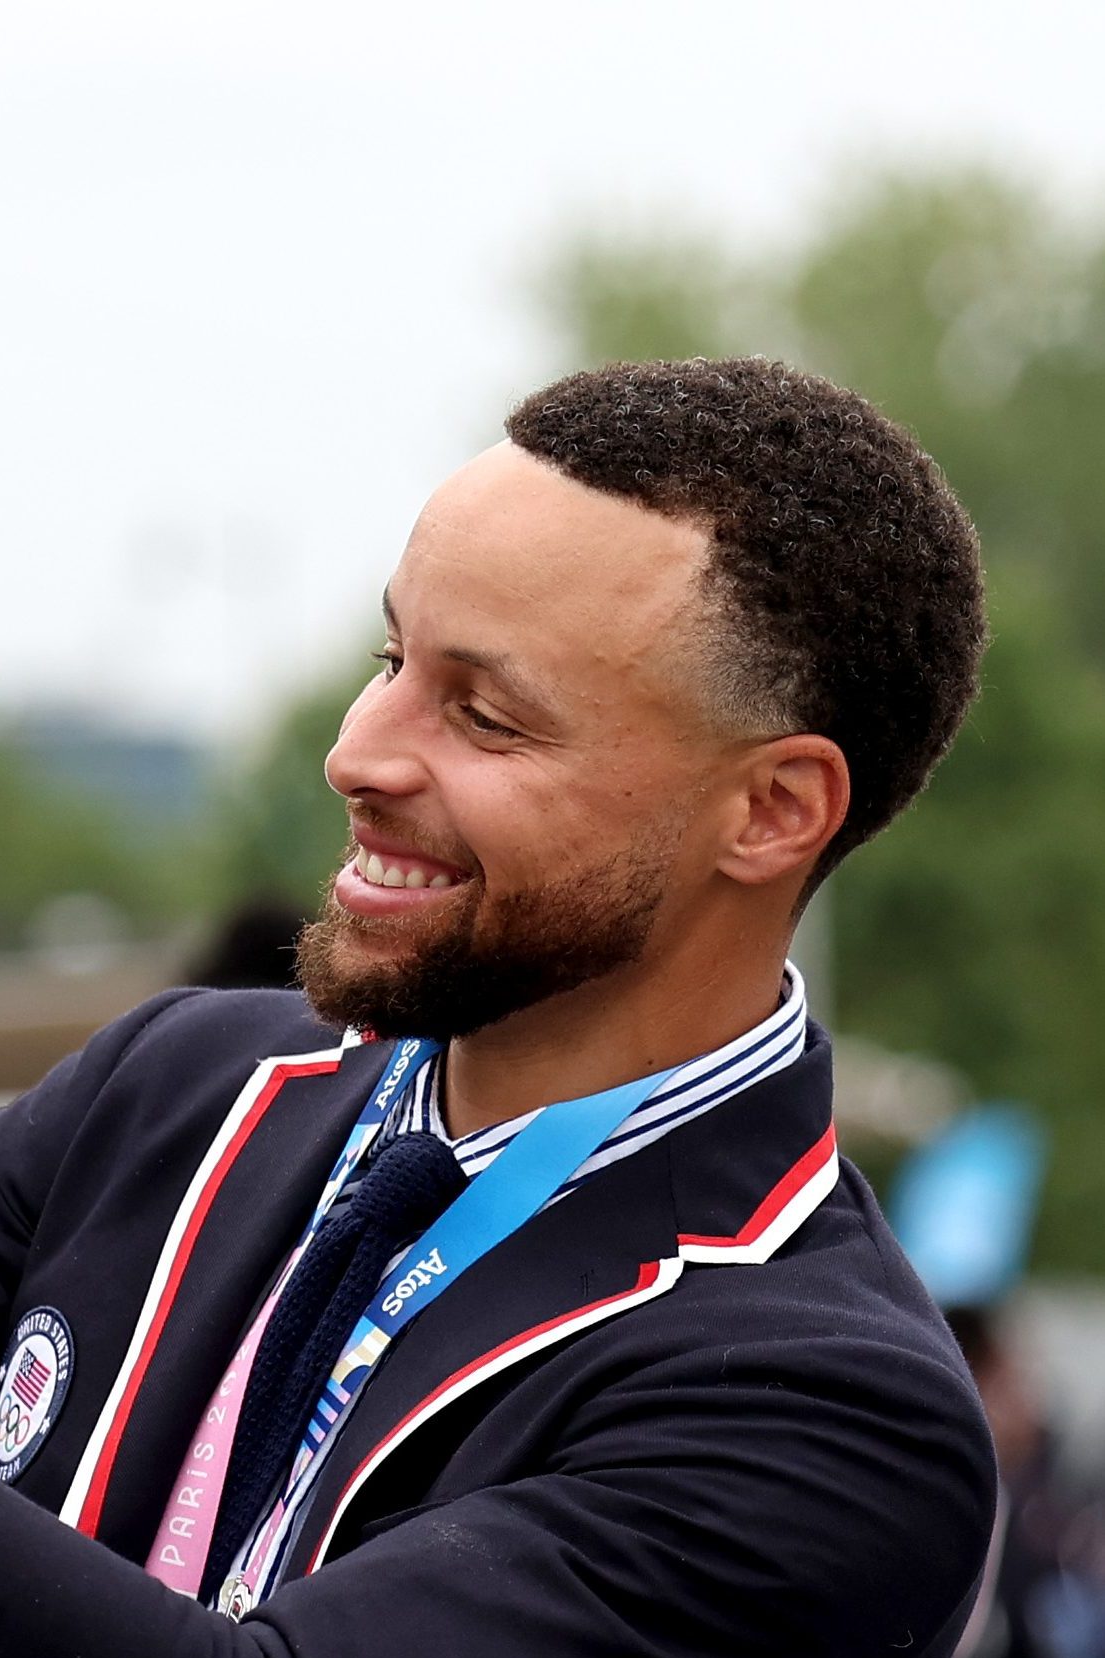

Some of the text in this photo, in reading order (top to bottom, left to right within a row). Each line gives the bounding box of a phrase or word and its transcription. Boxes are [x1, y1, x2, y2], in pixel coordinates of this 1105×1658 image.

[375, 1038, 421, 1110] Atos
[381, 1247, 447, 1317] Atos
[18, 1312, 71, 1382] UNITED STATES
